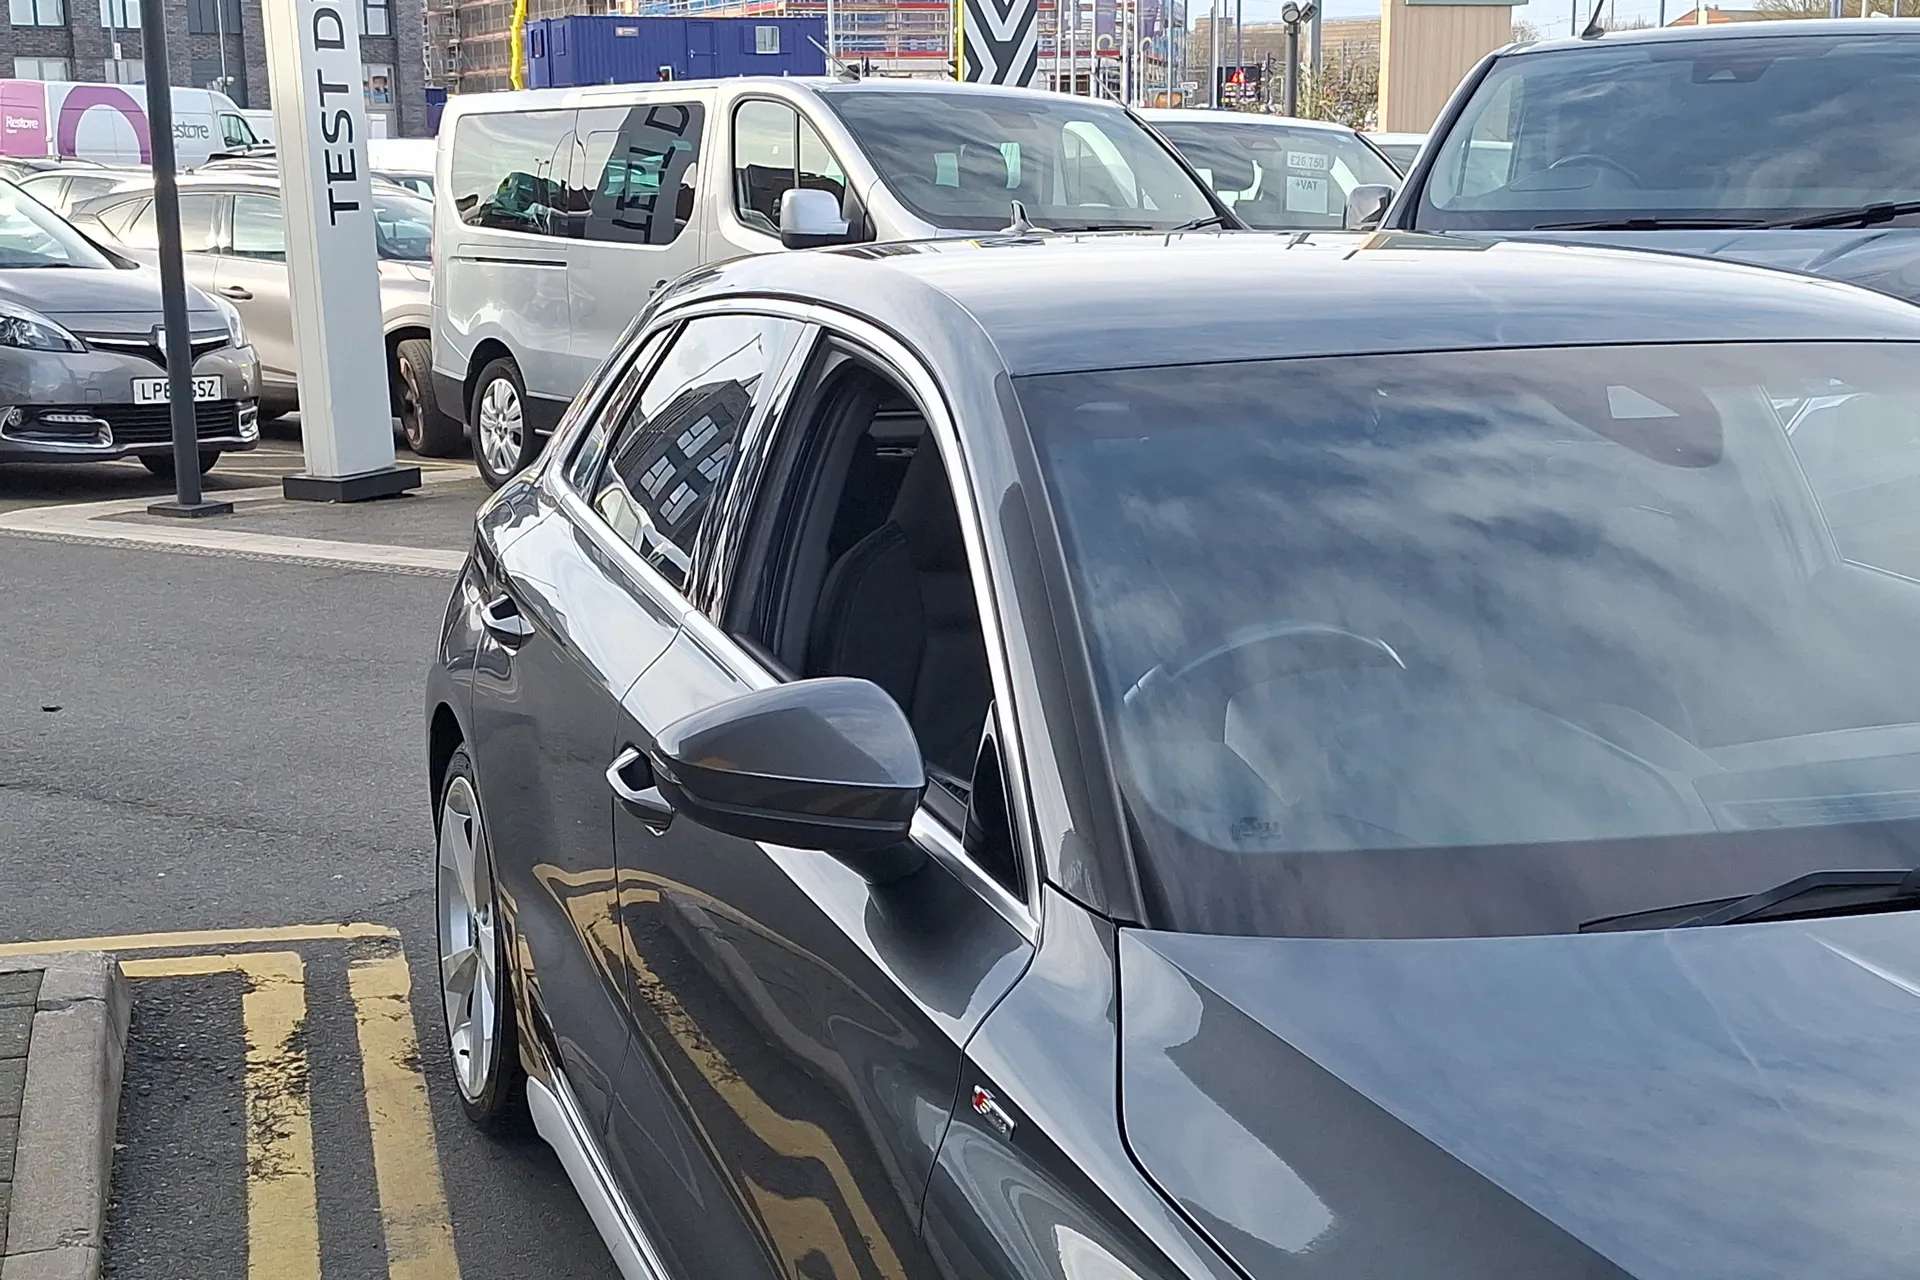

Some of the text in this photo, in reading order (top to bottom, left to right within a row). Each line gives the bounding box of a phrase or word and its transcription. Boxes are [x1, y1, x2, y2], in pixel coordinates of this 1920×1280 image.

[5, 115, 39, 129] Restore
[312, 0, 359, 226] TEST D
[172, 121, 210, 139] estore
